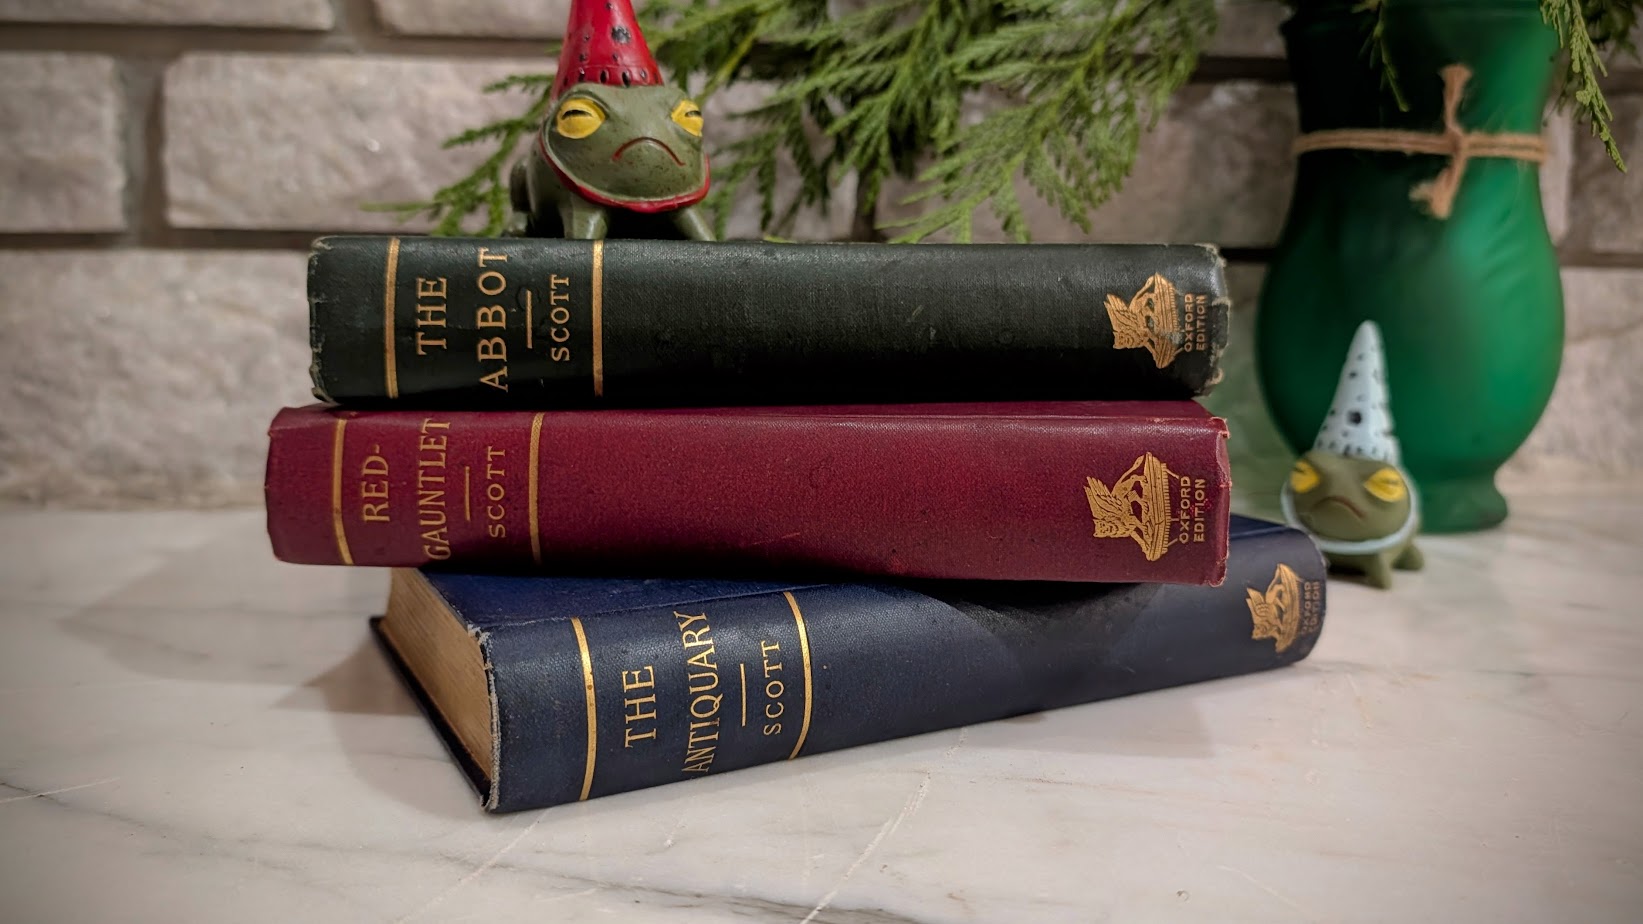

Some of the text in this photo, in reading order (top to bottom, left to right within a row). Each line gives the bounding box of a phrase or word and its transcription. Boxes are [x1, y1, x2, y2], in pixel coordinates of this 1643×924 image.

[416, 277, 447, 355] THE
[477, 246, 508, 393] ABBOT
[551, 274, 570, 362] SCOTT
[1184, 293, 1194, 352] OXFORD
[1196, 294, 1207, 351] EDITION
[362, 444, 390, 522] RED-
[417, 418, 451, 560] GAUNTLET
[487, 446, 506, 538] SCOTT
[1179, 476, 1191, 544] OXFORD
[1193, 479, 1206, 542] EDITION
[622, 665, 657, 748] THE
[673, 610, 723, 773] ANTIQUARY
[761, 640, 784, 736] SCOTT
